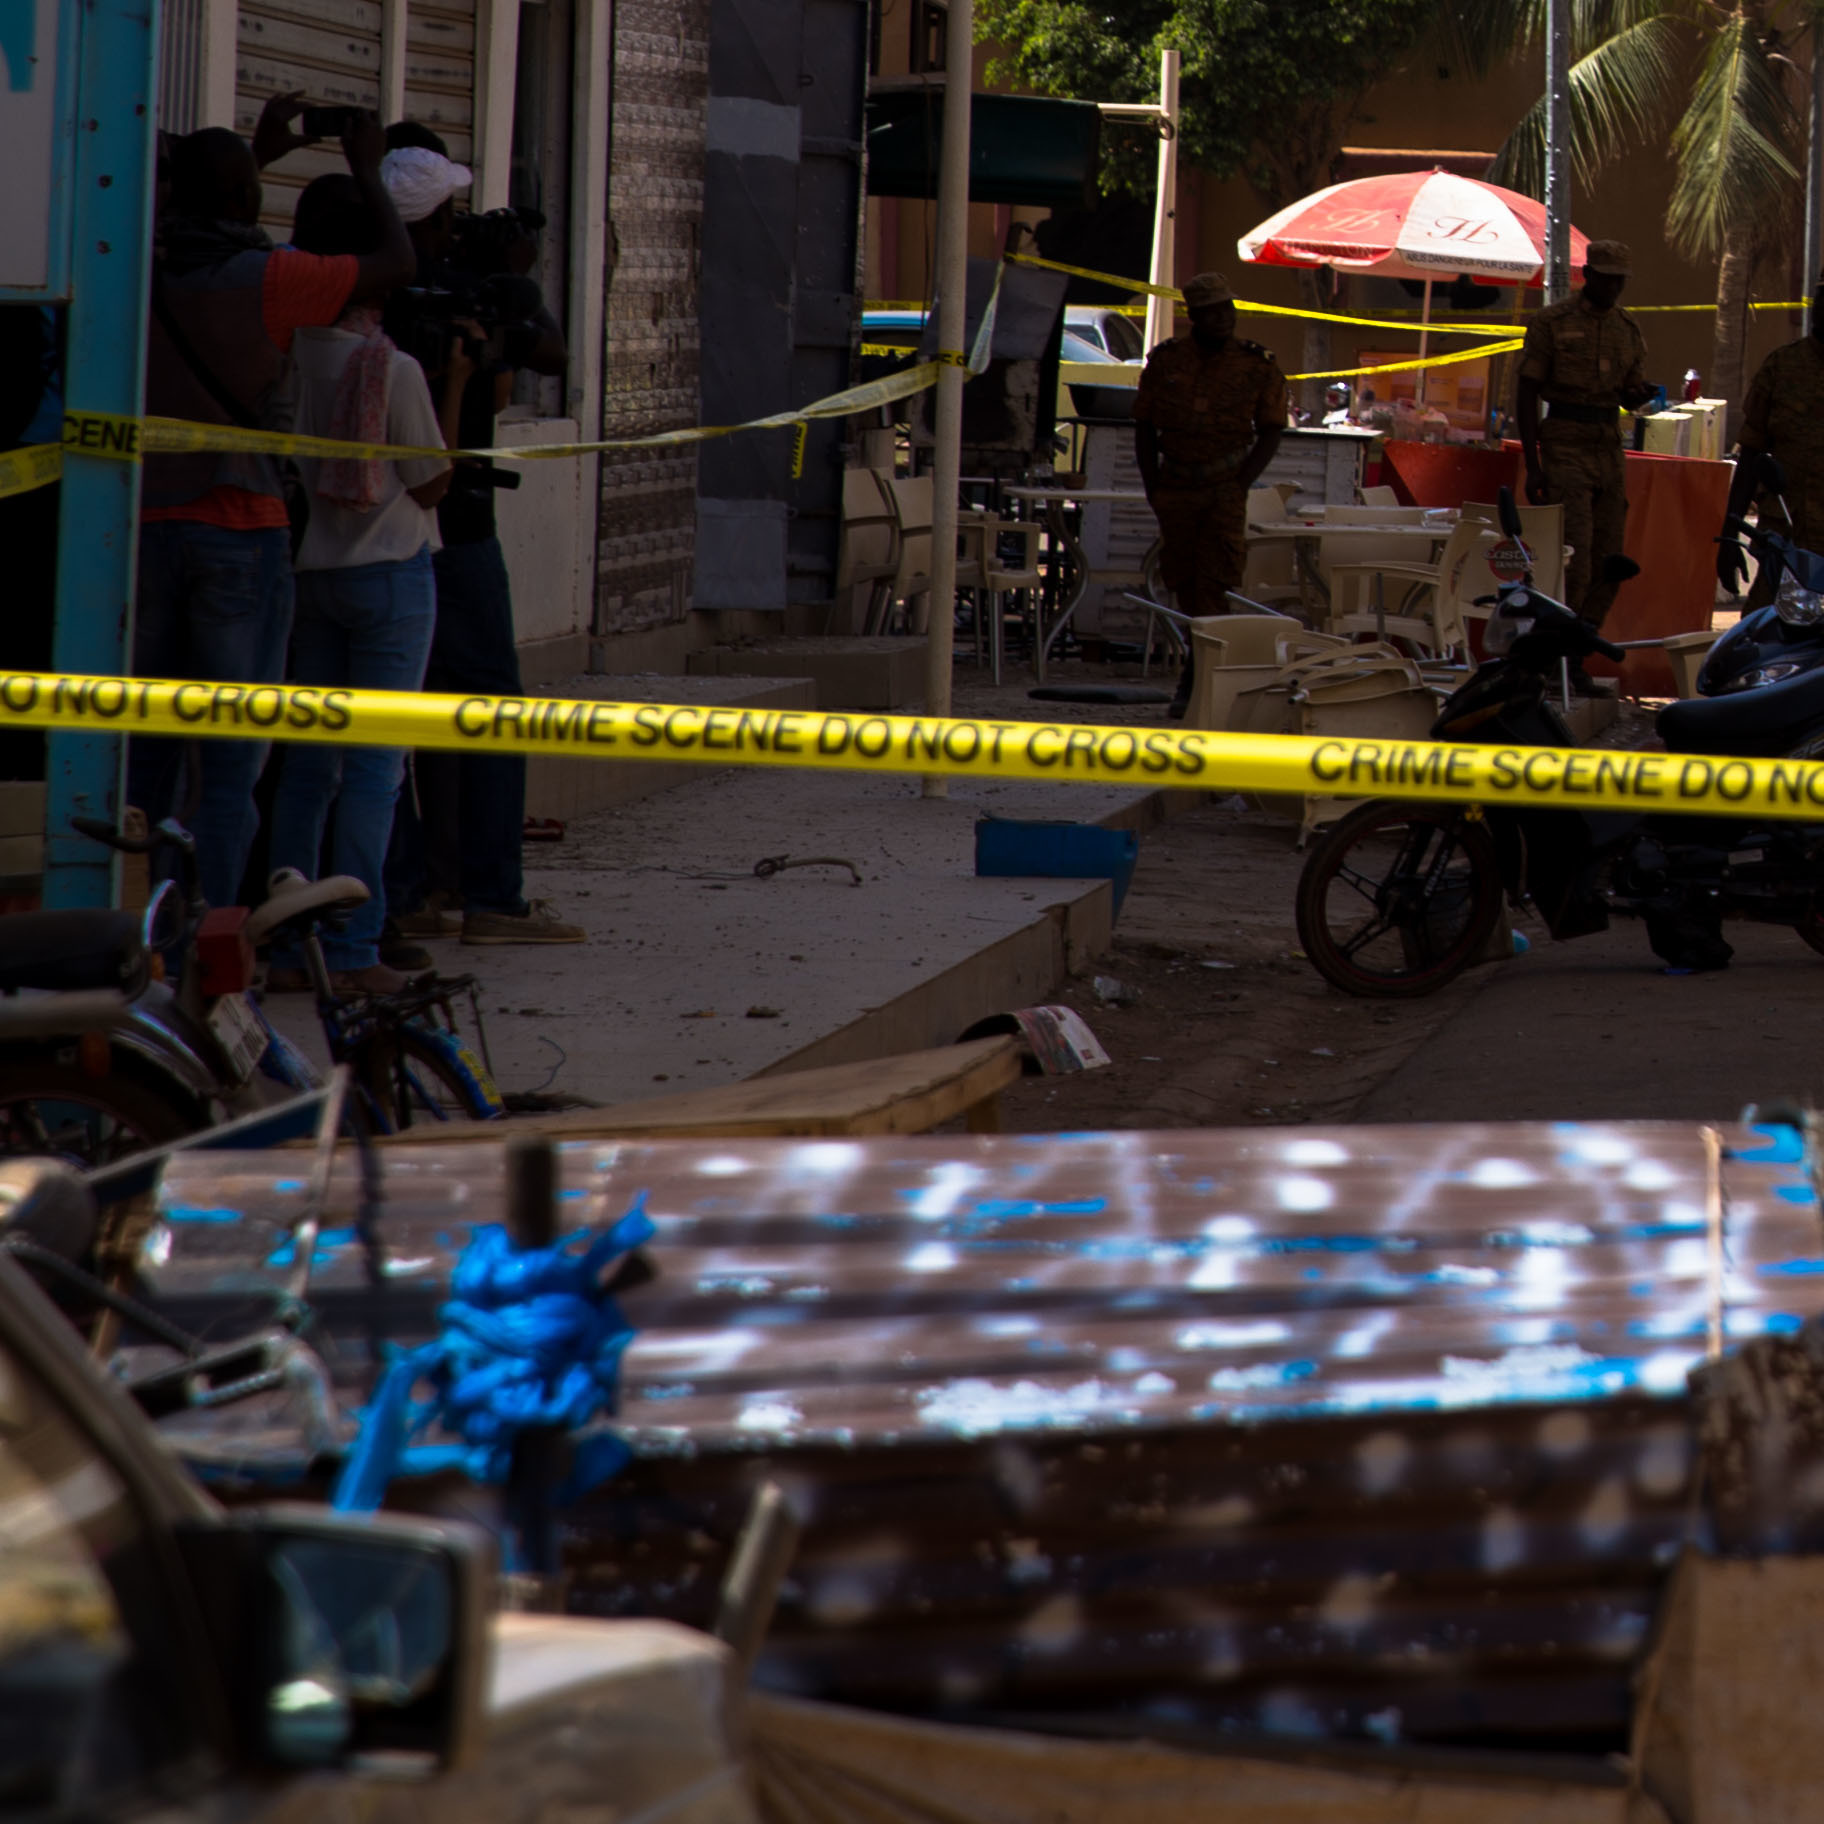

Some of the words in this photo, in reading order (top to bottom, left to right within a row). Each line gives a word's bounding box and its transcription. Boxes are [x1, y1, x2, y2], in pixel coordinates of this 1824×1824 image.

[53, 677, 163, 719] NOT
[172, 684, 353, 732] CROSS
[454, 696, 623, 743] CRIME
[630, 706, 803, 753] SCENE
[817, 716, 892, 758] DO
[906, 720, 1017, 763] NOT
[1026, 727, 1207, 775] CROSS
[1310, 741, 1479, 788] CRIME
[1488, 750, 1666, 797] SCENE
[1677, 758, 1754, 802] DO
